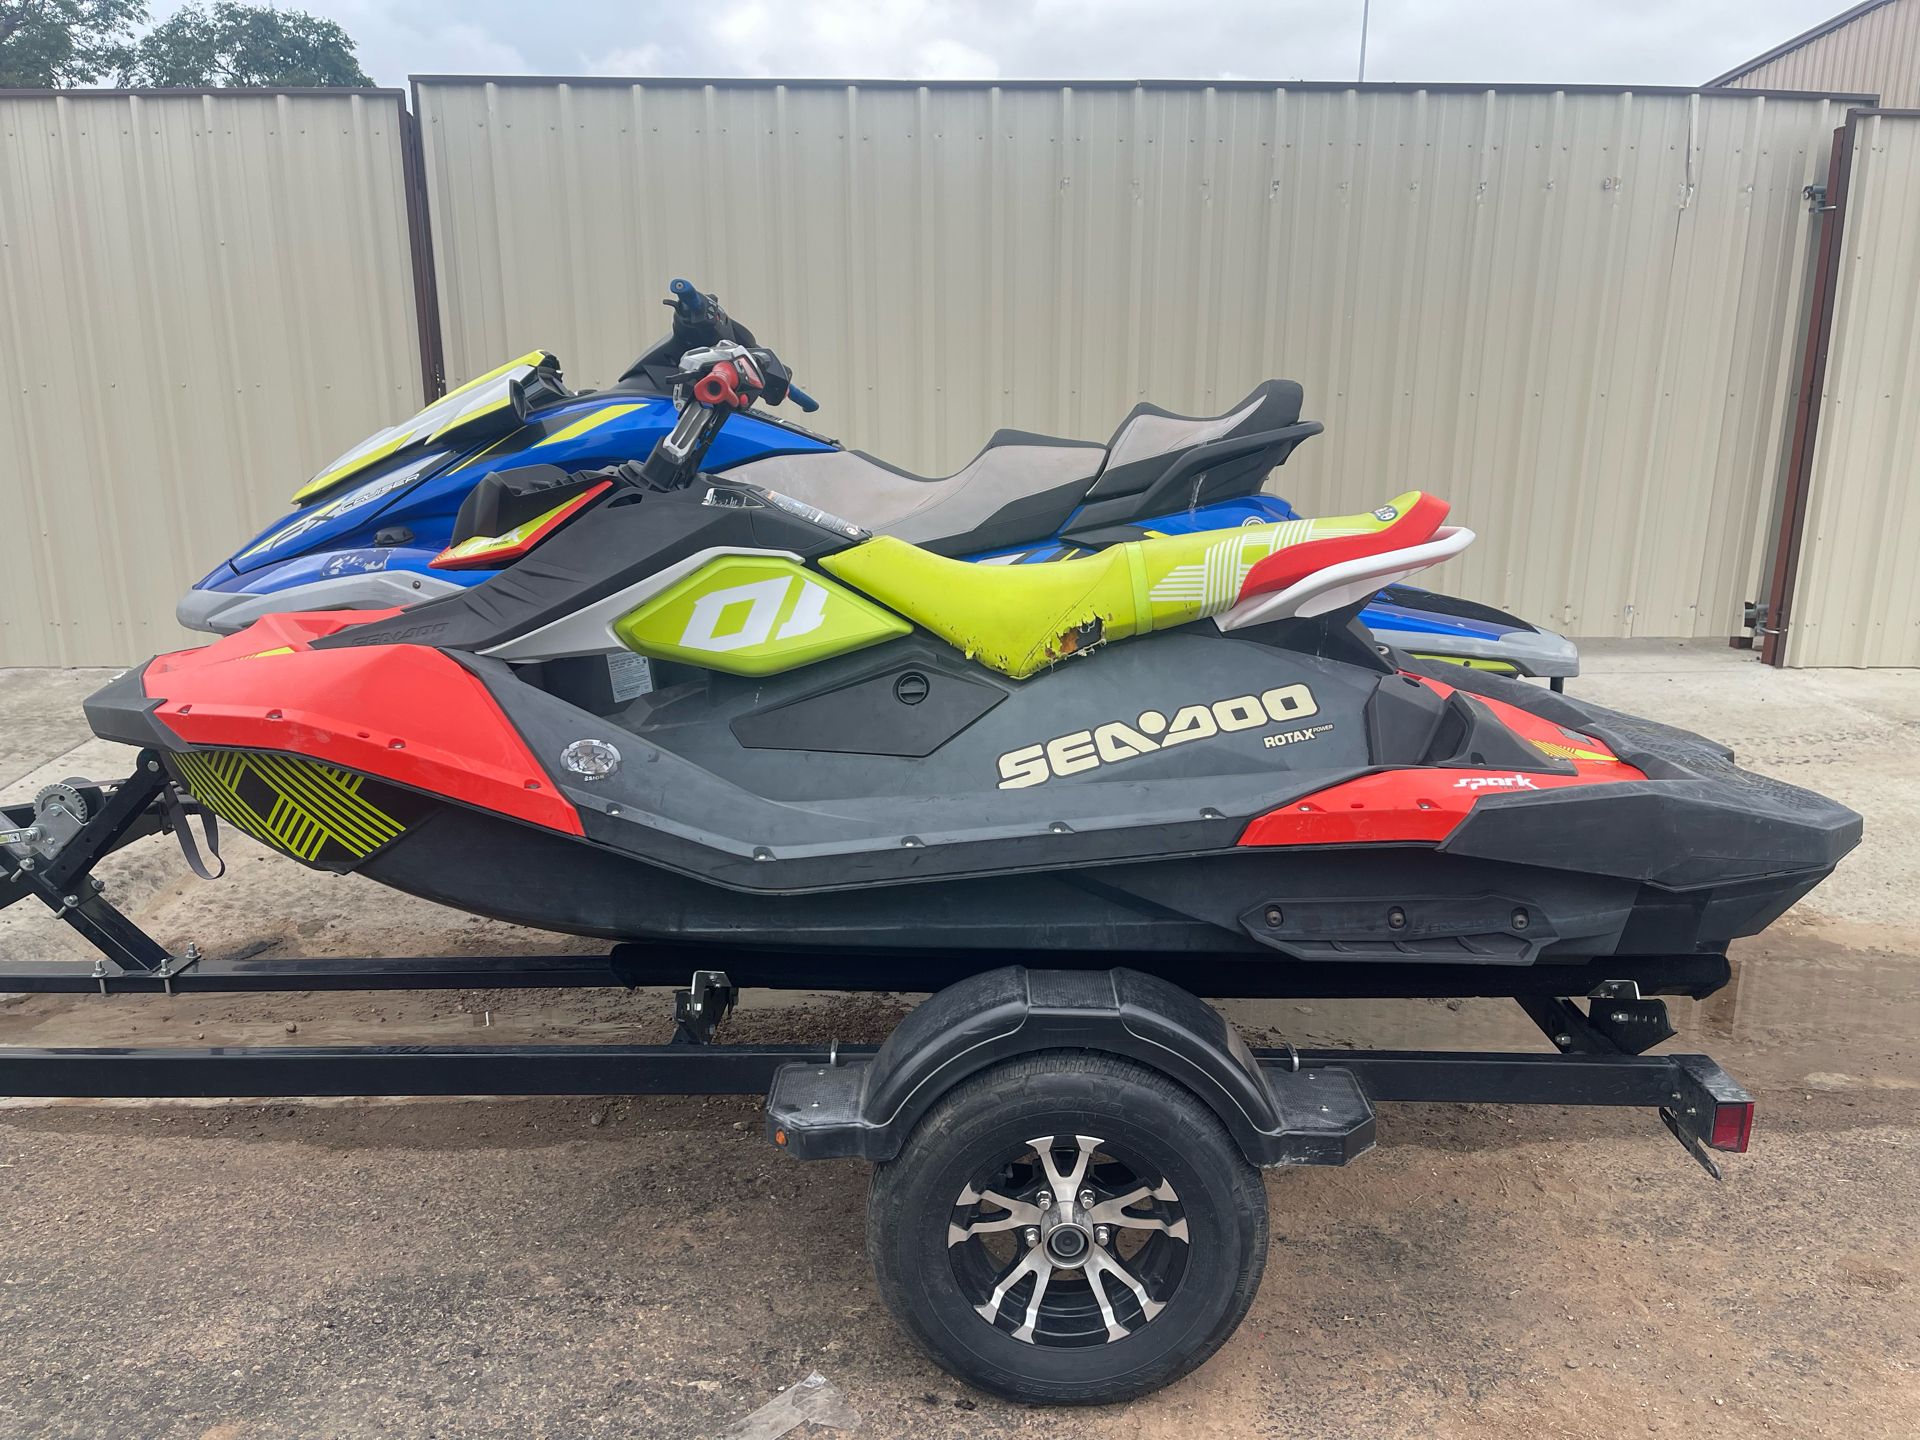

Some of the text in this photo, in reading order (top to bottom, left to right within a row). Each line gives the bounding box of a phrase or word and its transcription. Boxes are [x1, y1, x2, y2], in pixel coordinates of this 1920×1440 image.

[1263, 724, 1334, 748] ROTAX POWER
[1453, 774, 1540, 790] spark
